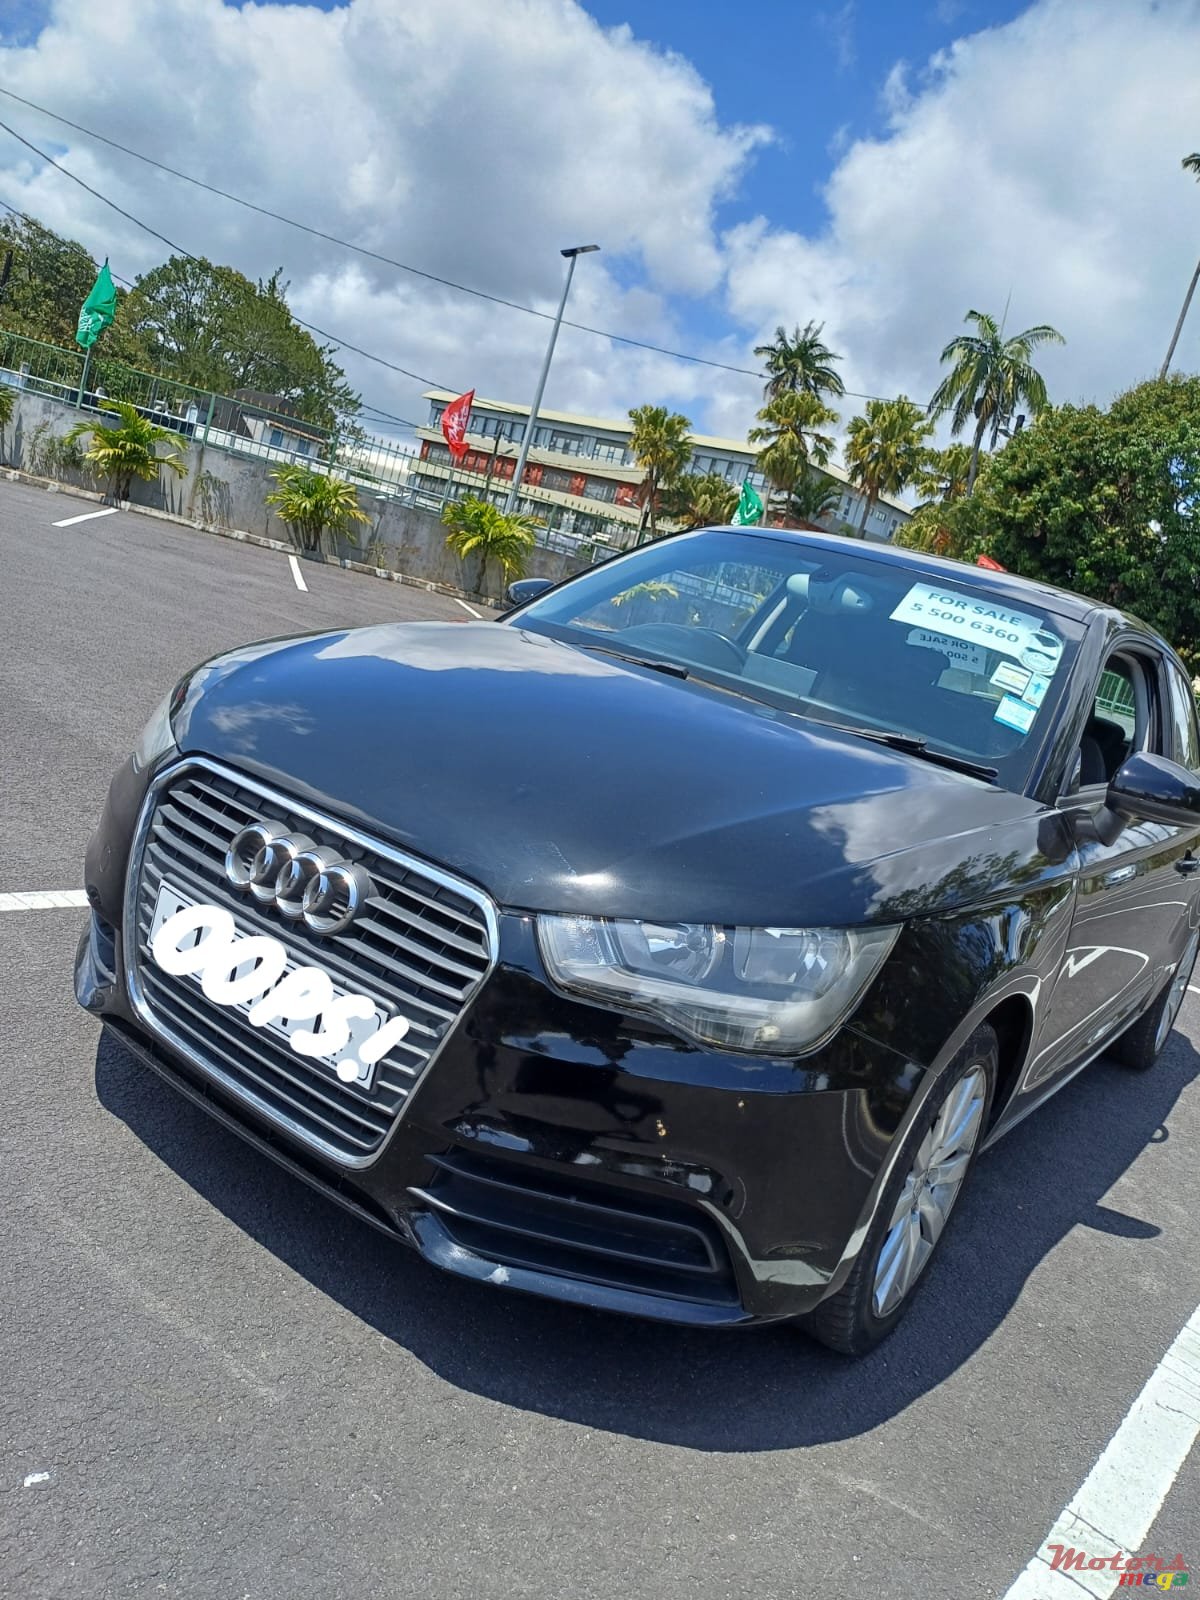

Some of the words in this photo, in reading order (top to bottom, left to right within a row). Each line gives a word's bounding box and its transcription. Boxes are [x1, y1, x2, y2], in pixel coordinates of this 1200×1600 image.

[911, 603, 924, 612] 5
[927, 608, 965, 625] 500
[970, 621, 1020, 643] 6360
[927, 592, 968, 611] FOR
[971, 605, 1022, 627] SALE
